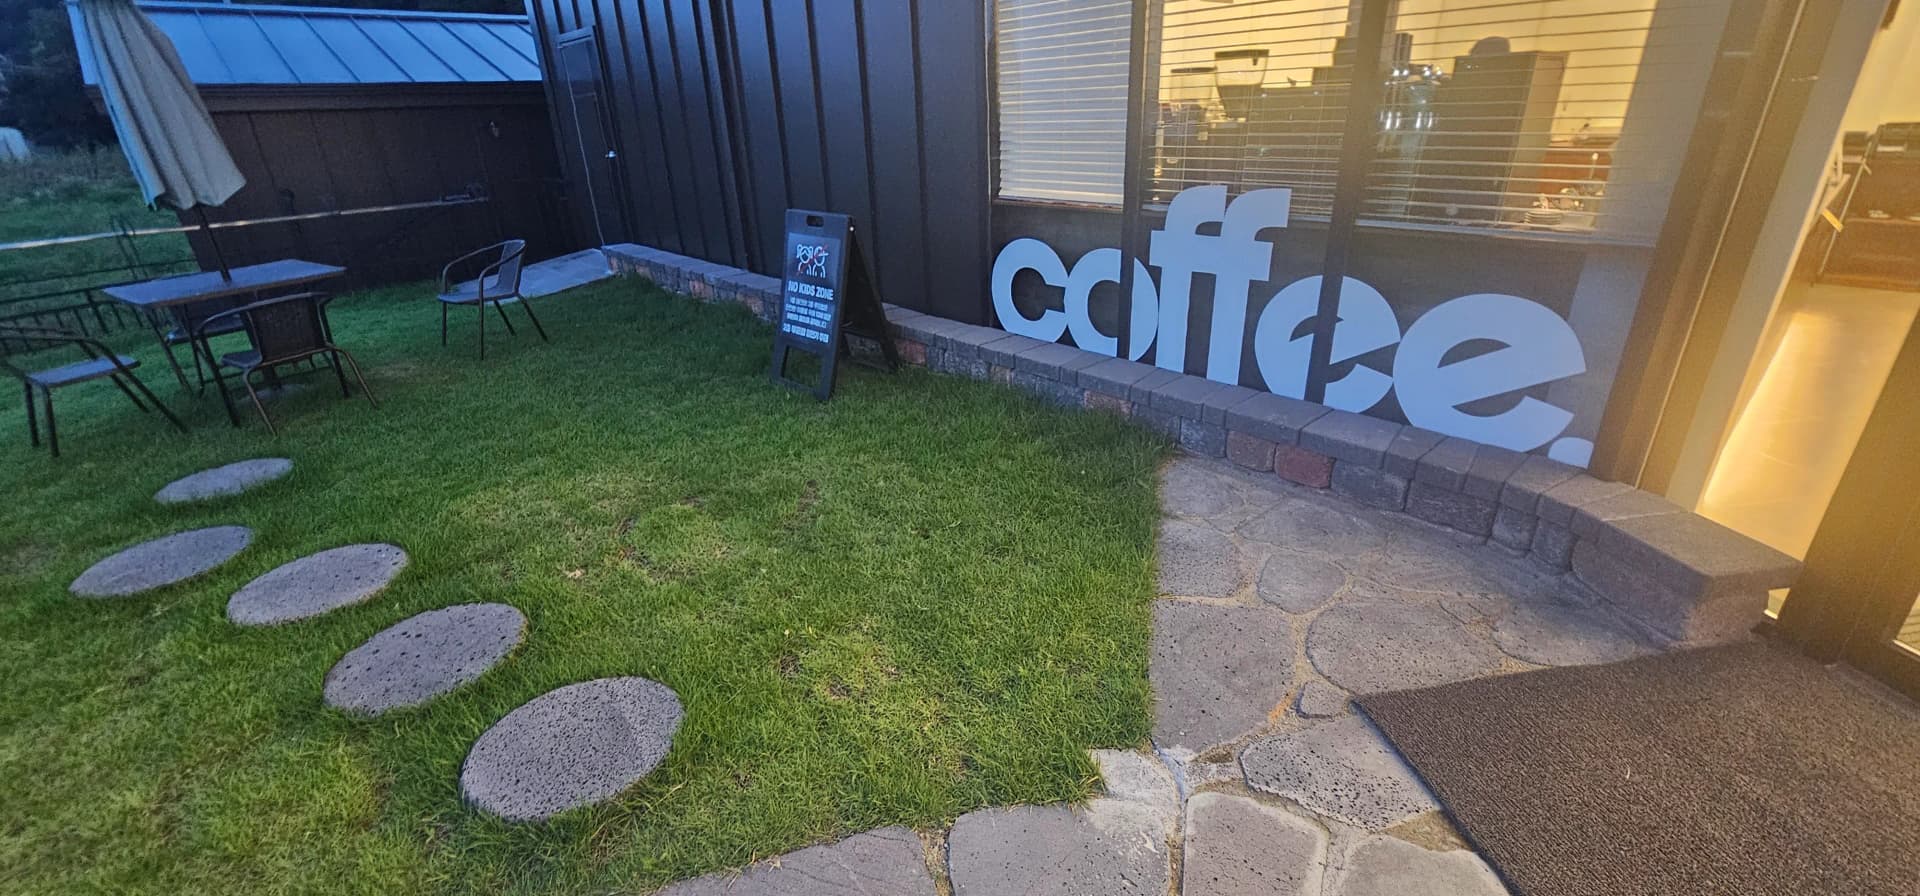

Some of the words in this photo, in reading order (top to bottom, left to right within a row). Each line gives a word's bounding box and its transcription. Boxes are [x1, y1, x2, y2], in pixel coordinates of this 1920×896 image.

[788, 280, 798, 293] NO
[799, 282, 815, 296] KIDS
[815, 286, 833, 300] ZONE
[991, 185, 1594, 469] coffee.
